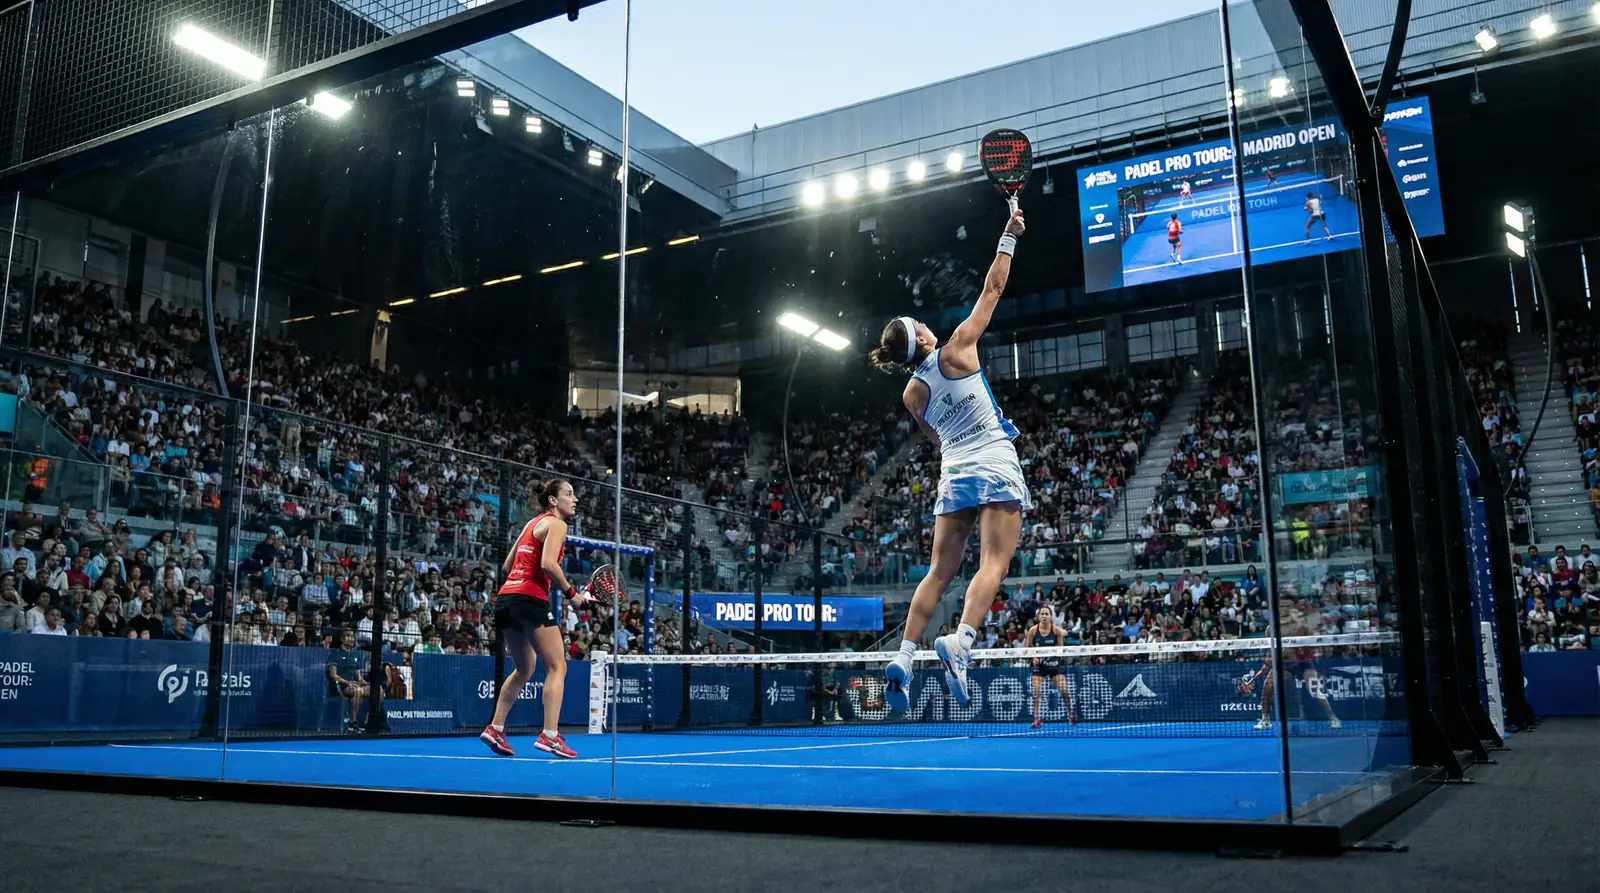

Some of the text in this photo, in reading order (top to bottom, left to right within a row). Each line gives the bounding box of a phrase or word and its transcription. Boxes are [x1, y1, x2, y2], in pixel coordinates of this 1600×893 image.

[1124, 160, 1164, 180] PADEL
[1165, 154, 1191, 173] PRO
[1193, 146, 1233, 166] TOUR:
[1243, 131, 1296, 156] MADRID
[1298, 123, 1336, 145] OPEN
[1191, 205, 1227, 220] PADEL
[1248, 196, 1278, 209] TOUR
[716, 602, 837, 622] PADE PRO TOR:
[0, 661, 36, 673] PADEL
